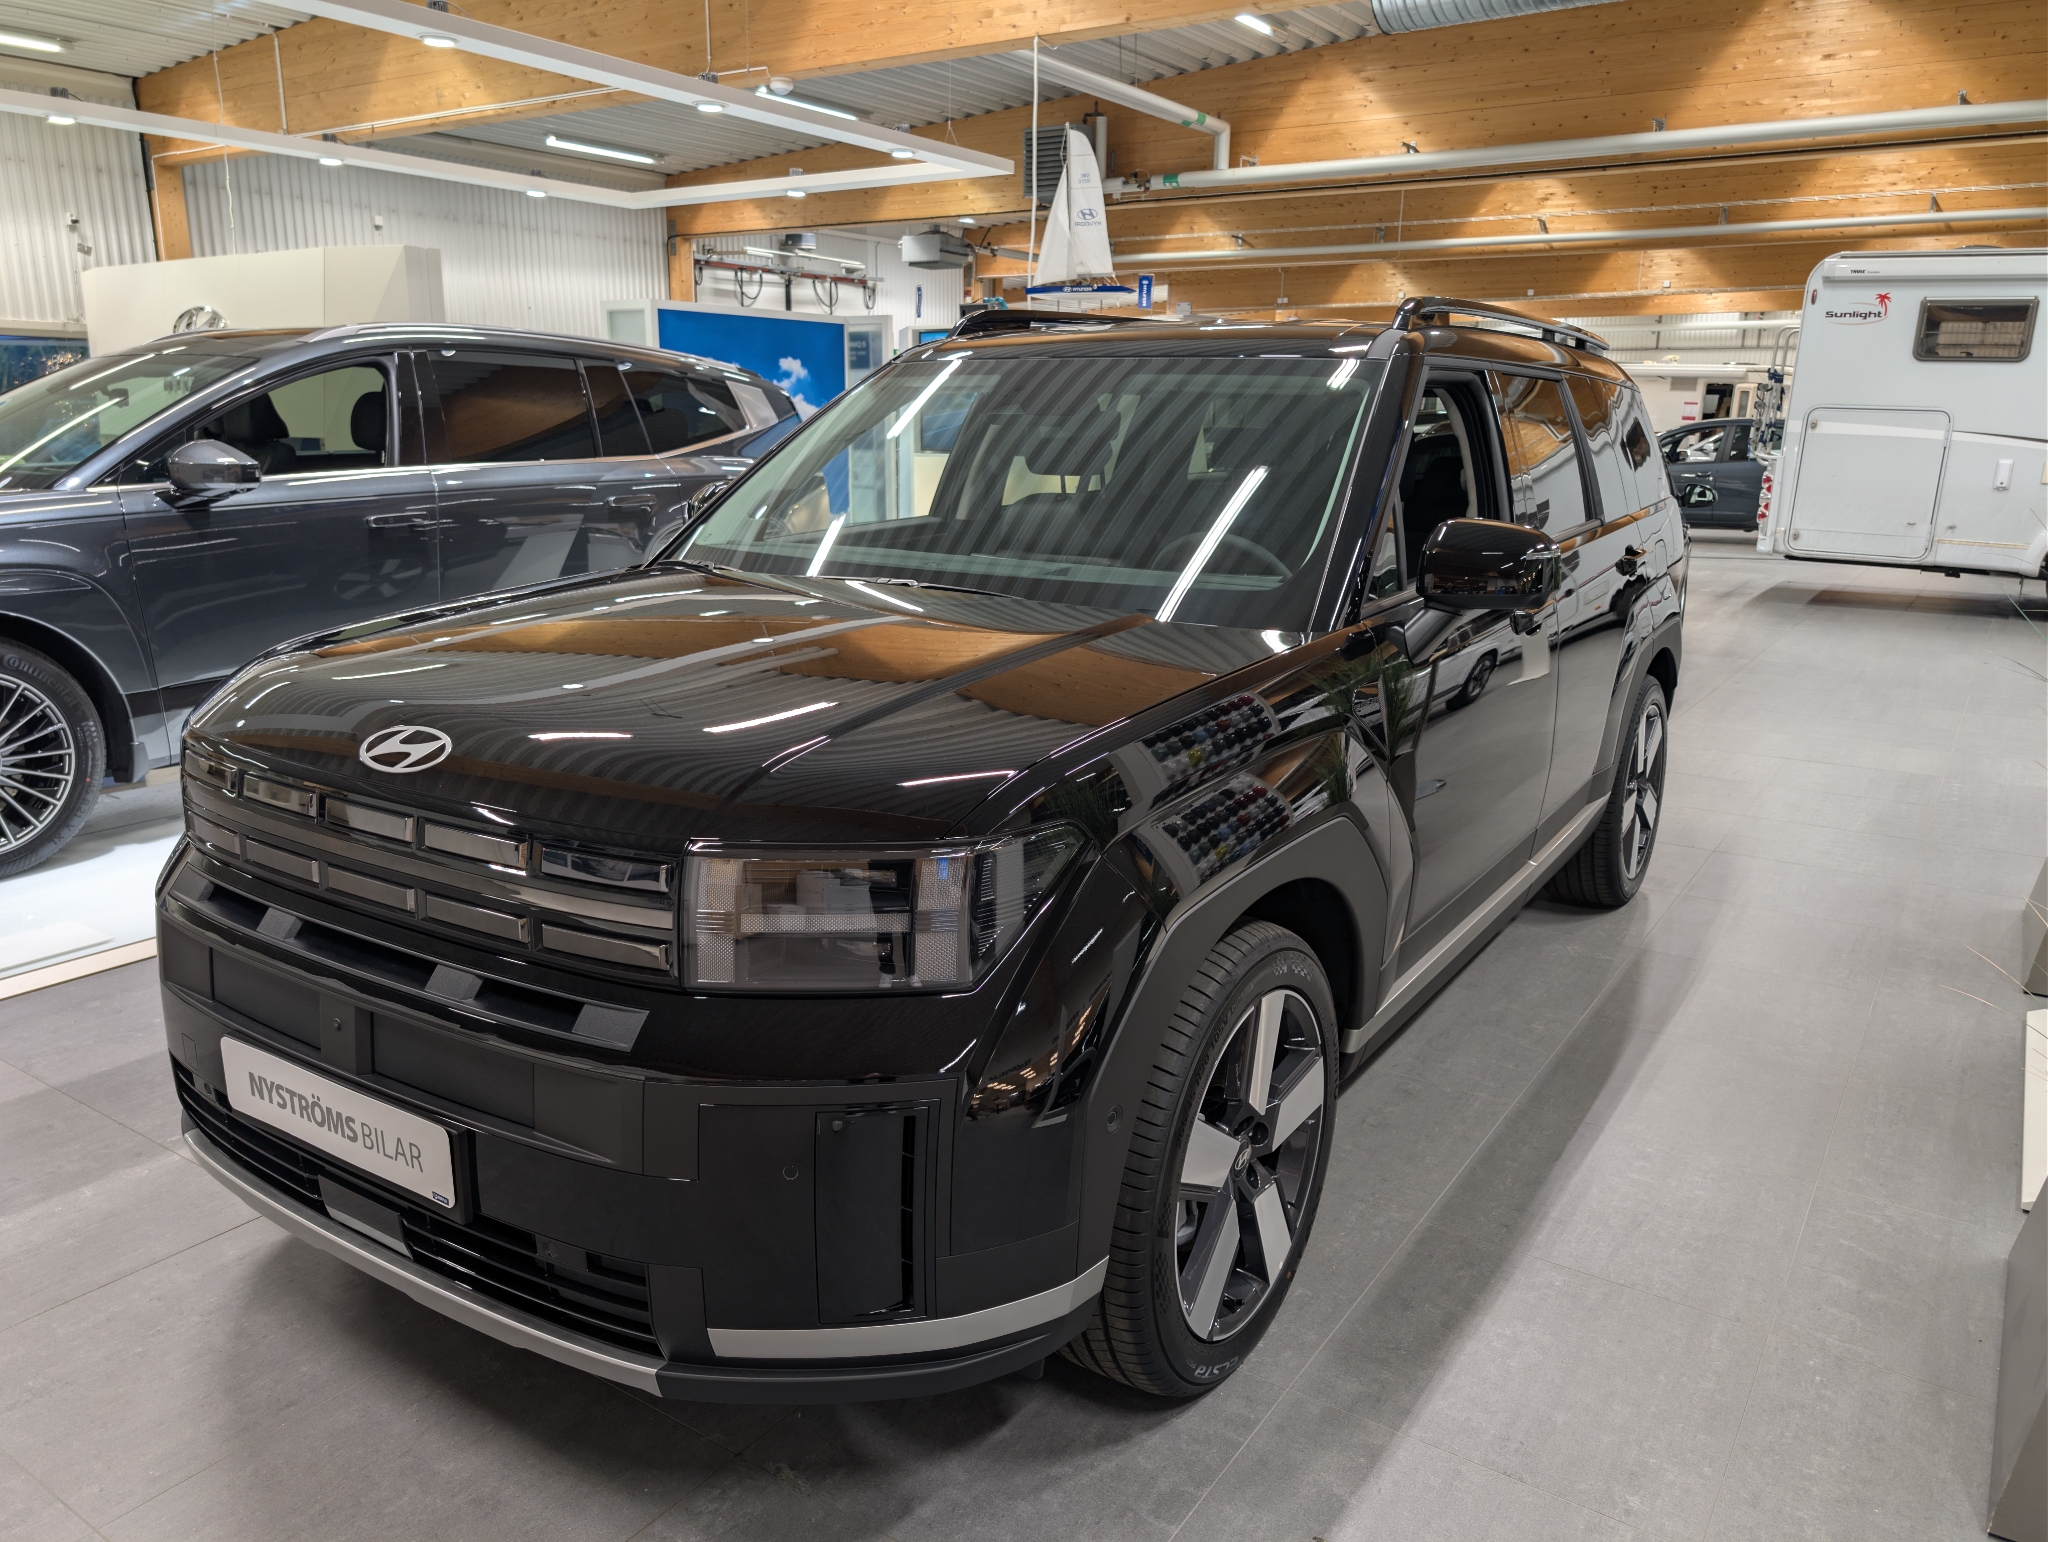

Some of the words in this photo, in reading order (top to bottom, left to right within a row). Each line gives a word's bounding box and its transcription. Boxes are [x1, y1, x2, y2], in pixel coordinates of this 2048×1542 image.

[1825, 311, 1882, 320] Sunlight
[3, 654, 79, 707] Continental
[248, 1071, 358, 1143] NYSTRÖMS
[361, 1122, 424, 1173] BILAR
